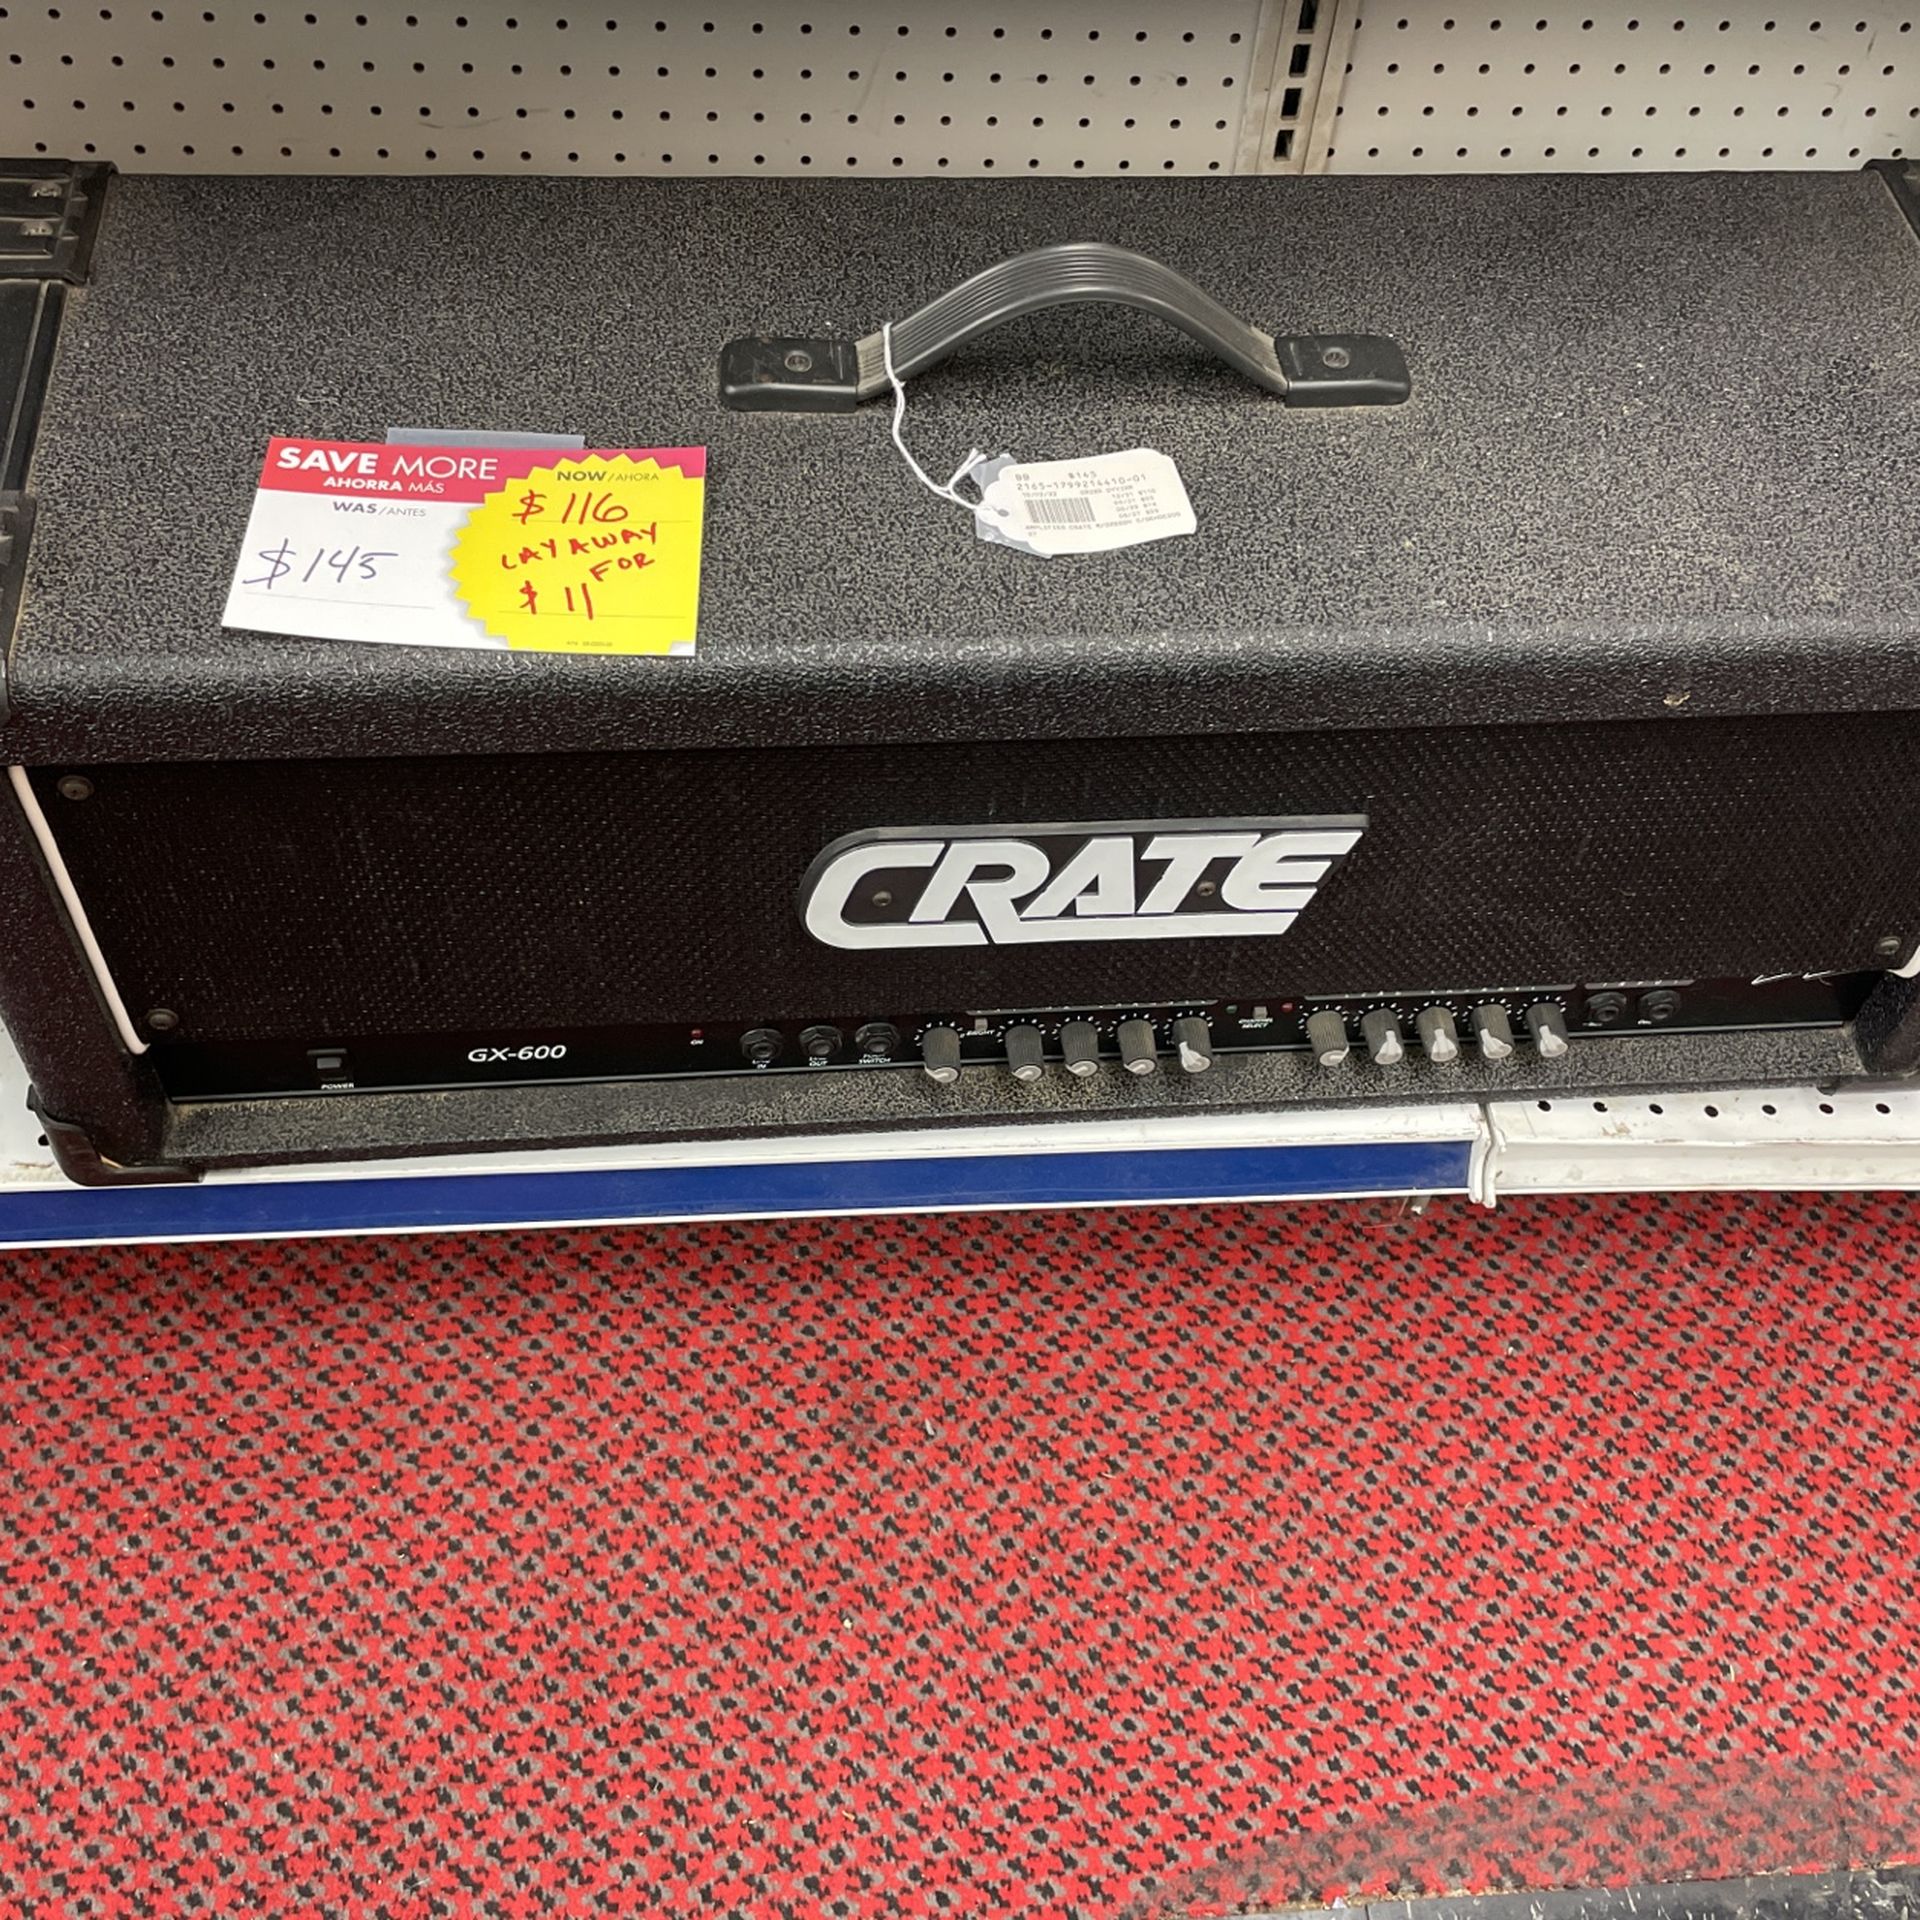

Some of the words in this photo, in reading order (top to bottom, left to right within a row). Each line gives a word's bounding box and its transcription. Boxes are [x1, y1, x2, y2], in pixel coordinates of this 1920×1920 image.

[276, 446, 379, 475] SAVE
[391, 455, 498, 481] MORE
[1068, 470, 1098, 480] $145
[323, 476, 403, 492] AHORRA
[408, 480, 445, 494] MÁS
[242, 537, 399, 590] $145
[589, 552, 655, 582] FOR
[805, 830, 1363, 949] CRATE
[467, 1044, 567, 1063] GX-600
[320, 1082, 354, 1090] POWER
